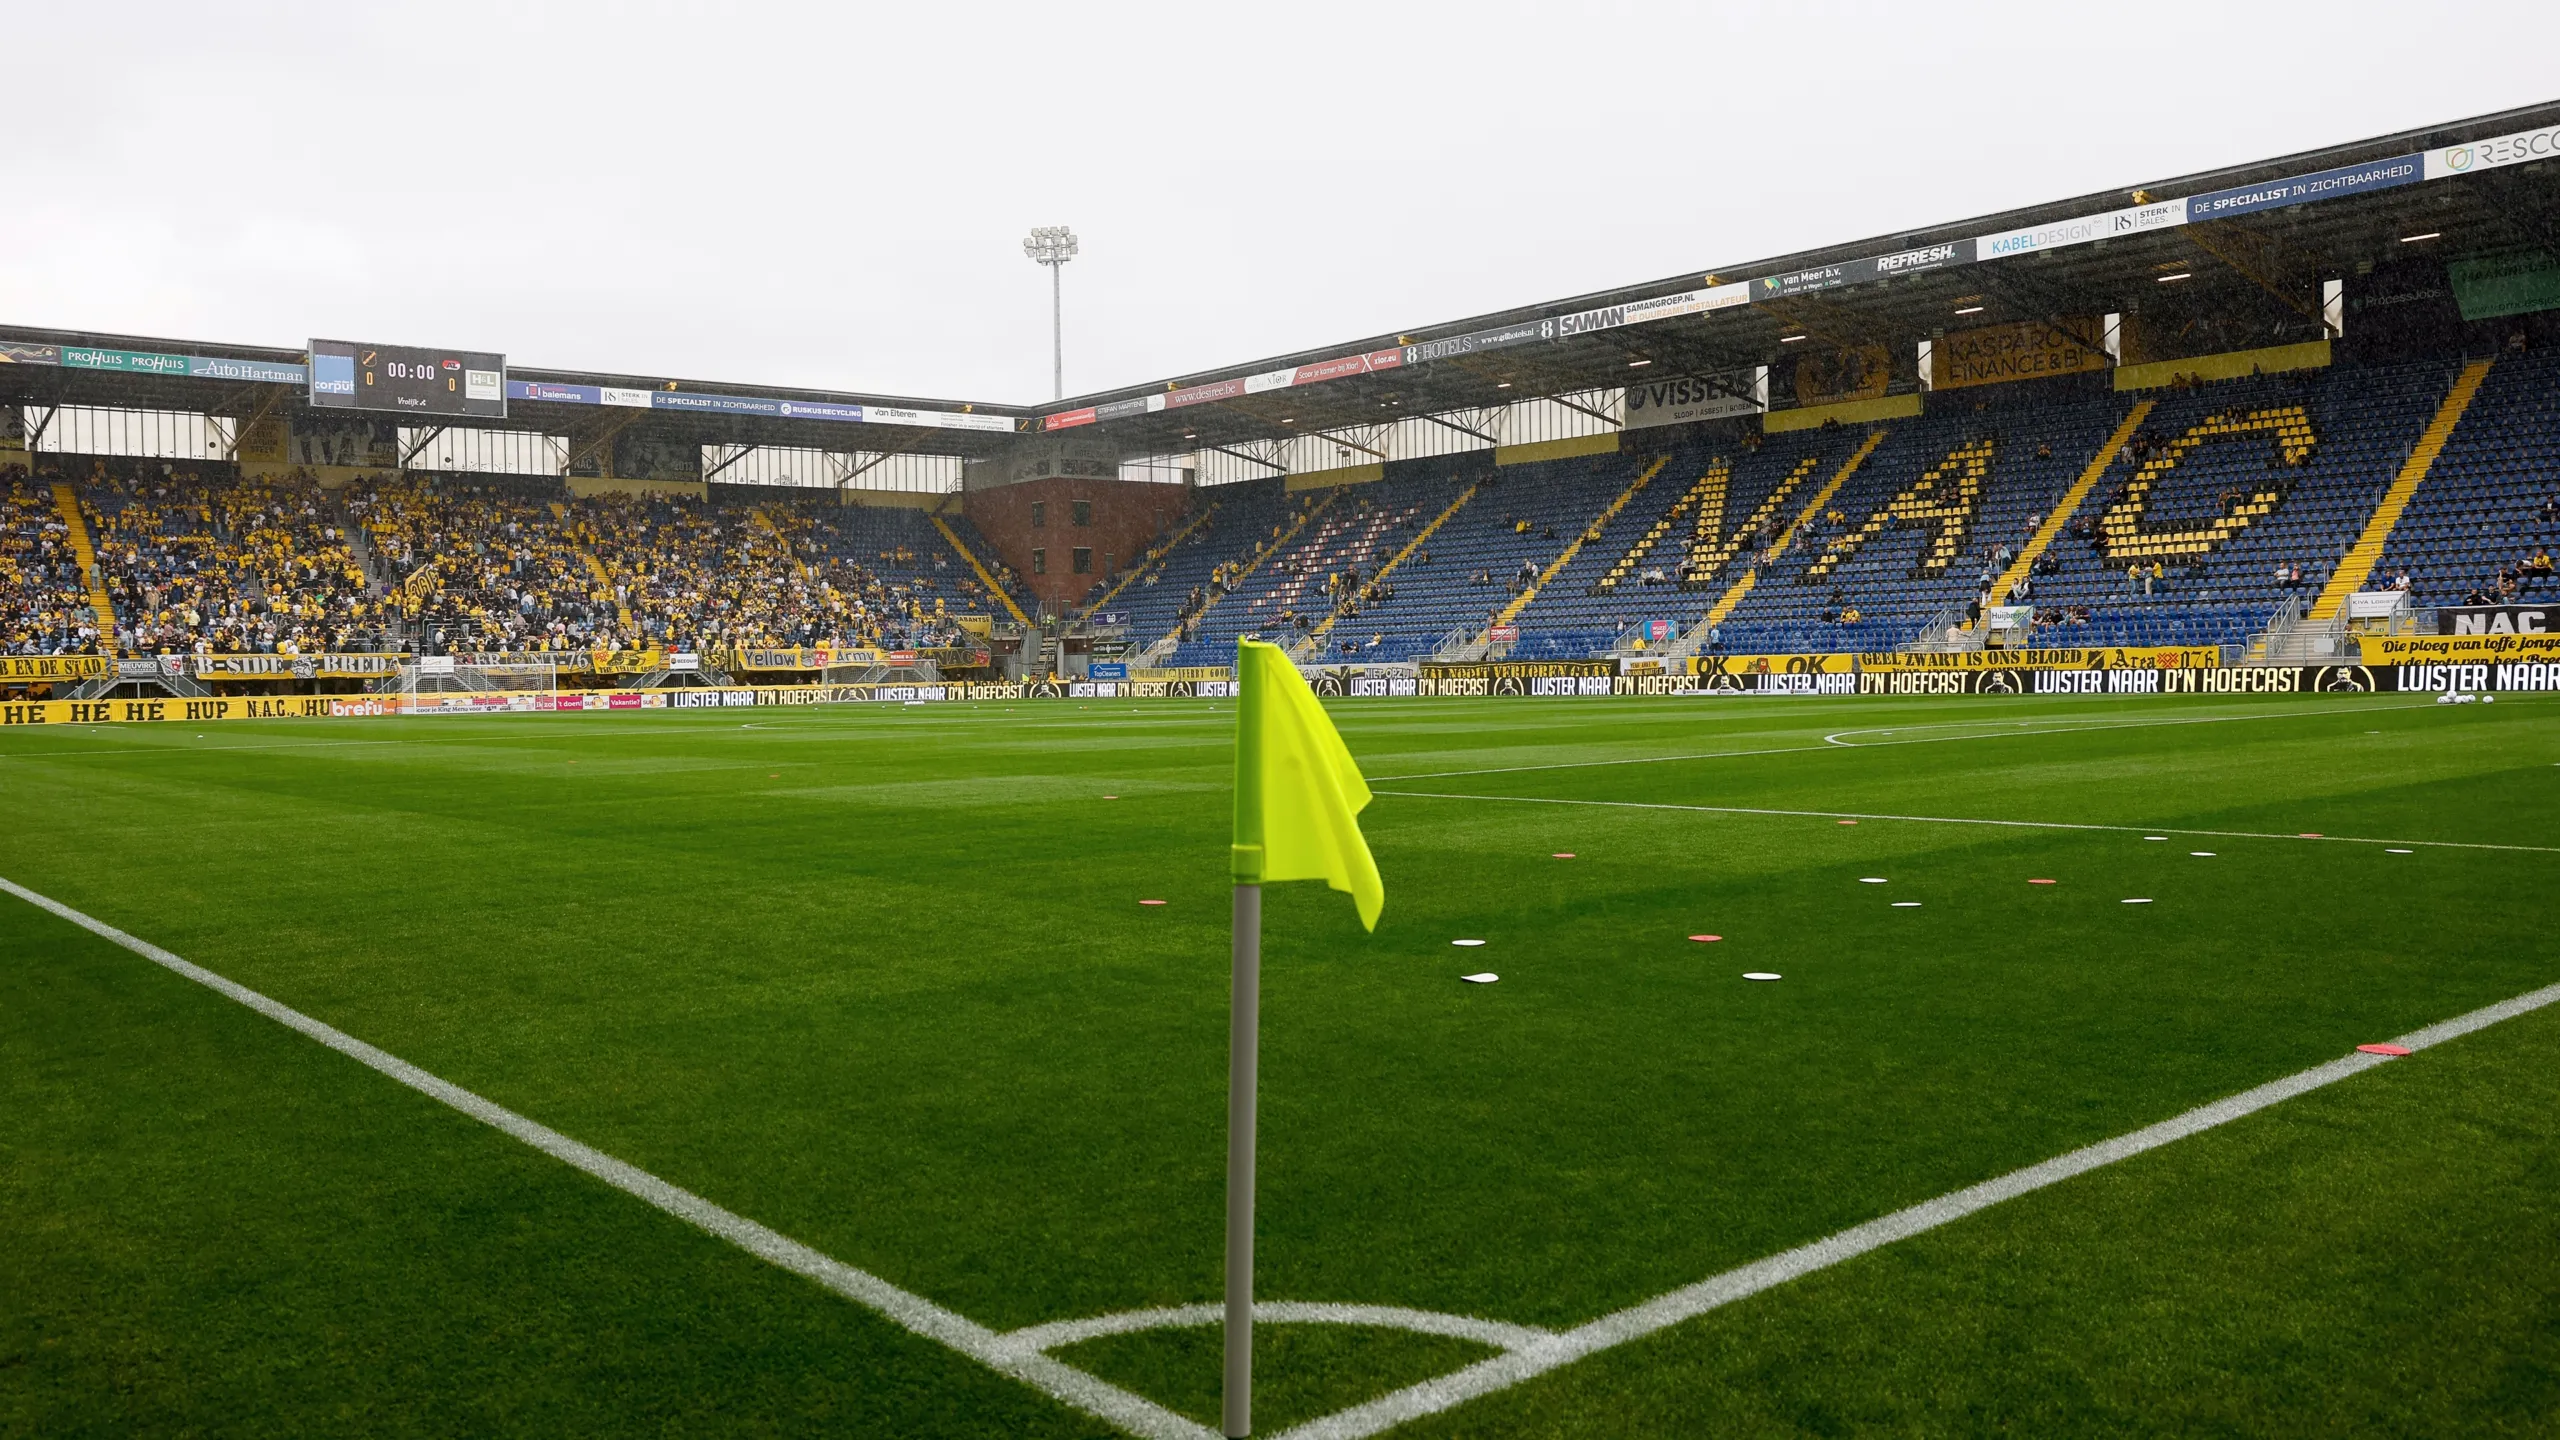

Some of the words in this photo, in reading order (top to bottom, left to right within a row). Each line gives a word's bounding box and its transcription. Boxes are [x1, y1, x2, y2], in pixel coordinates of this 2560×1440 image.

[2195, 203, 2210, 214] DE
[2213, 188, 2289, 210] SPECIALIST
[2292, 185, 2306, 196] IN
[2310, 165, 2413, 192] ZICHTBAARHEID
[2140, 207, 2169, 219] STERK
[2171, 204, 2181, 212] IN
[1991, 224, 2092, 255] KABELDESIGN
[1783, 276, 1799, 285] van
[1800, 271, 1823, 282] Meer
[1826, 267, 1841, 278] b.v.
[1626, 293, 1695, 313] SAMANGROEP.NL
[1626, 313, 1640, 323] DE
[1641, 306, 1685, 321] DUURZAME
[1686, 294, 1748, 312] INSTALLATEUR
[1561, 307, 1624, 335] SAMAN
[205, 360, 239, 376] Auto
[241, 365, 303, 381] Hartman
[366, 371, 374, 386] 0
[388, 362, 435, 380] 00:00
[1299, 370, 1313, 380] Scoor
[448, 377, 456, 392] 0
[1174, 383, 1236, 404] www.desiree.be
[542, 390, 582, 400] balemans
[656, 396, 667, 404] DE
[667, 397, 711, 407] SPECIALIST
[722, 400, 776, 412] ZICHTBAARHEID
[792, 405, 821, 415] RUSKUS
[822, 408, 862, 418] RECYCLING
[1700, 407, 1725, 417] ASBEST
[1730, 403, 1752, 413] BODEM
[2455, 611, 2547, 636] NAC
[2382, 639, 2406, 654] Die
[2409, 639, 2450, 655] ploeg
[2453, 641, 2481, 651] van
[2484, 636, 2517, 653] toffe
[15, 658, 34, 675] EN
[39, 658, 57, 675] DE
[64, 657, 101, 675] STAD
[195, 656, 283, 675] B-SIDE
[323, 655, 400, 675] BREDA
[744, 651, 796, 668] Yellow
[837, 650, 876, 663] Army
[1696, 656, 1730, 677] OK
[1786, 655, 1829, 674] OK
[1862, 652, 1901, 666] GEEL
[1905, 652, 1963, 667] ZWART
[1965, 652, 1982, 666] IS
[1987, 650, 2021, 666] ONS
[2026, 649, 2082, 665] BLOED
[1093, 670, 1121, 678] TopCleaners
[1757, 673, 1812, 691] LUISTER
[1816, 673, 1856, 694] NAAR
[1860, 673, 1885, 694] D'N
[1891, 671, 1968, 694] HOEFCAST
[2034, 670, 2102, 693] LUISTER
[2107, 670, 2159, 693] NAAR
[2164, 669, 2196, 693] D'N
[2201, 667, 2304, 692] HOEFCAST
[2397, 665, 2487, 691] LUISTER
[1069, 683, 1096, 698] LUISTER
[1098, 683, 1116, 698] NAAR
[1117, 683, 1130, 698] D'N
[1132, 682, 1167, 698] HOEFCAST
[1197, 682, 1226, 697] LUISTER
[1228, 682, 1240, 697] NA
[1350, 678, 1388, 696] LUISTER
[1390, 678, 1416, 696] NAAR
[1418, 678, 1436, 696] D'N
[1439, 677, 1489, 696] HOEFCAST
[1531, 677, 1576, 696] LUISTER
[1578, 676, 1611, 696] NAAR
[1614, 676, 1635, 695] D'N
[1638, 675, 1700, 695] HOEFCAST
[305, 699, 335, 717] HU
[610, 699, 641, 708] Vakantie?
[674, 692, 719, 708] LUISTER
[723, 691, 754, 706] NAAR
[759, 691, 776, 706] D'N
[779, 690, 833, 705] HOEFCAST
[186, 701, 229, 720] HUP
[332, 701, 383, 717] brefu
